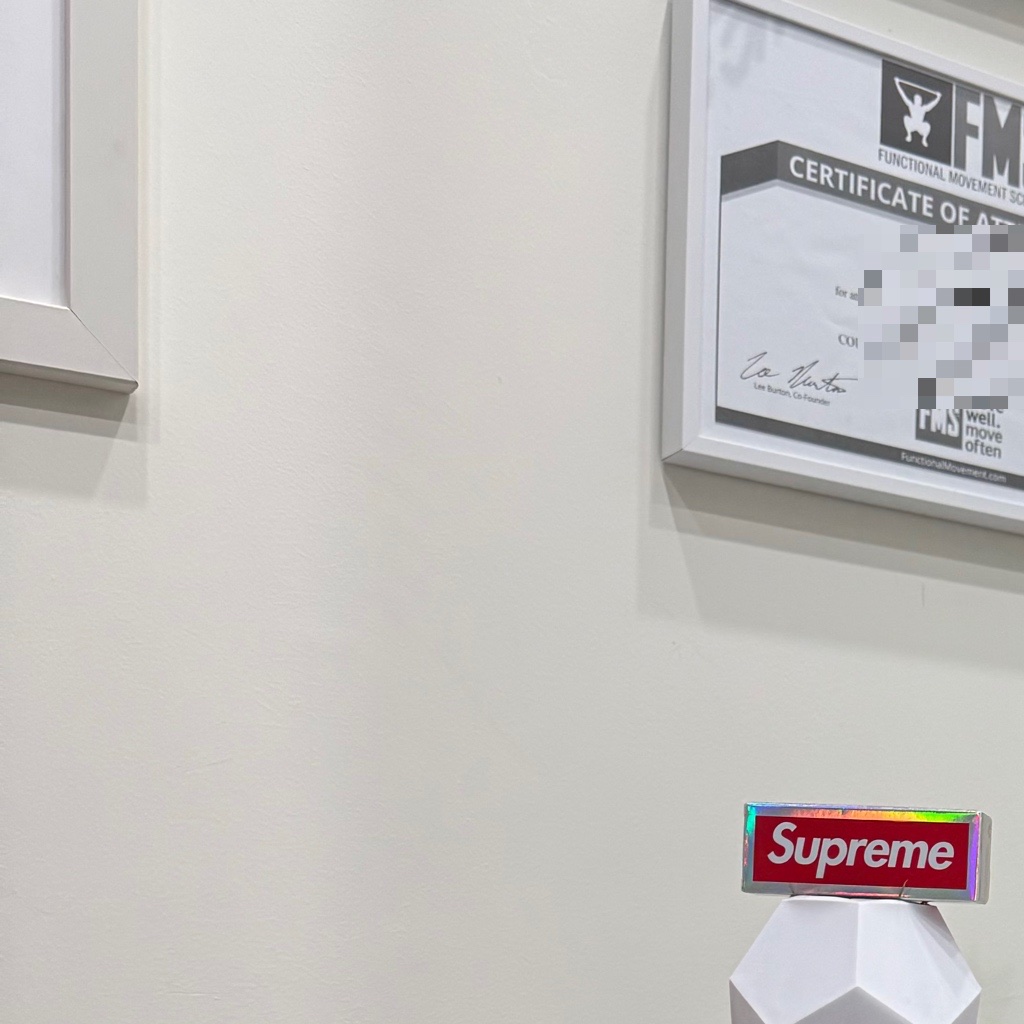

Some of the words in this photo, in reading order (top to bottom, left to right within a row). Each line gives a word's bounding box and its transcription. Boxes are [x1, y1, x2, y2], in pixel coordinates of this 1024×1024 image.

[878, 147, 946, 182] FUNCTIONAL
[948, 168, 1007, 201] MOVEMENT
[789, 154, 935, 219] CERTIFICATE
[939, 201, 971, 226] OF
[965, 409, 1001, 429] well.
[965, 425, 1003, 444] move
[965, 439, 1002, 459] often
[900, 452, 1007, 483] FunctionalMovement.com
[767, 821, 955, 879] Supreme
